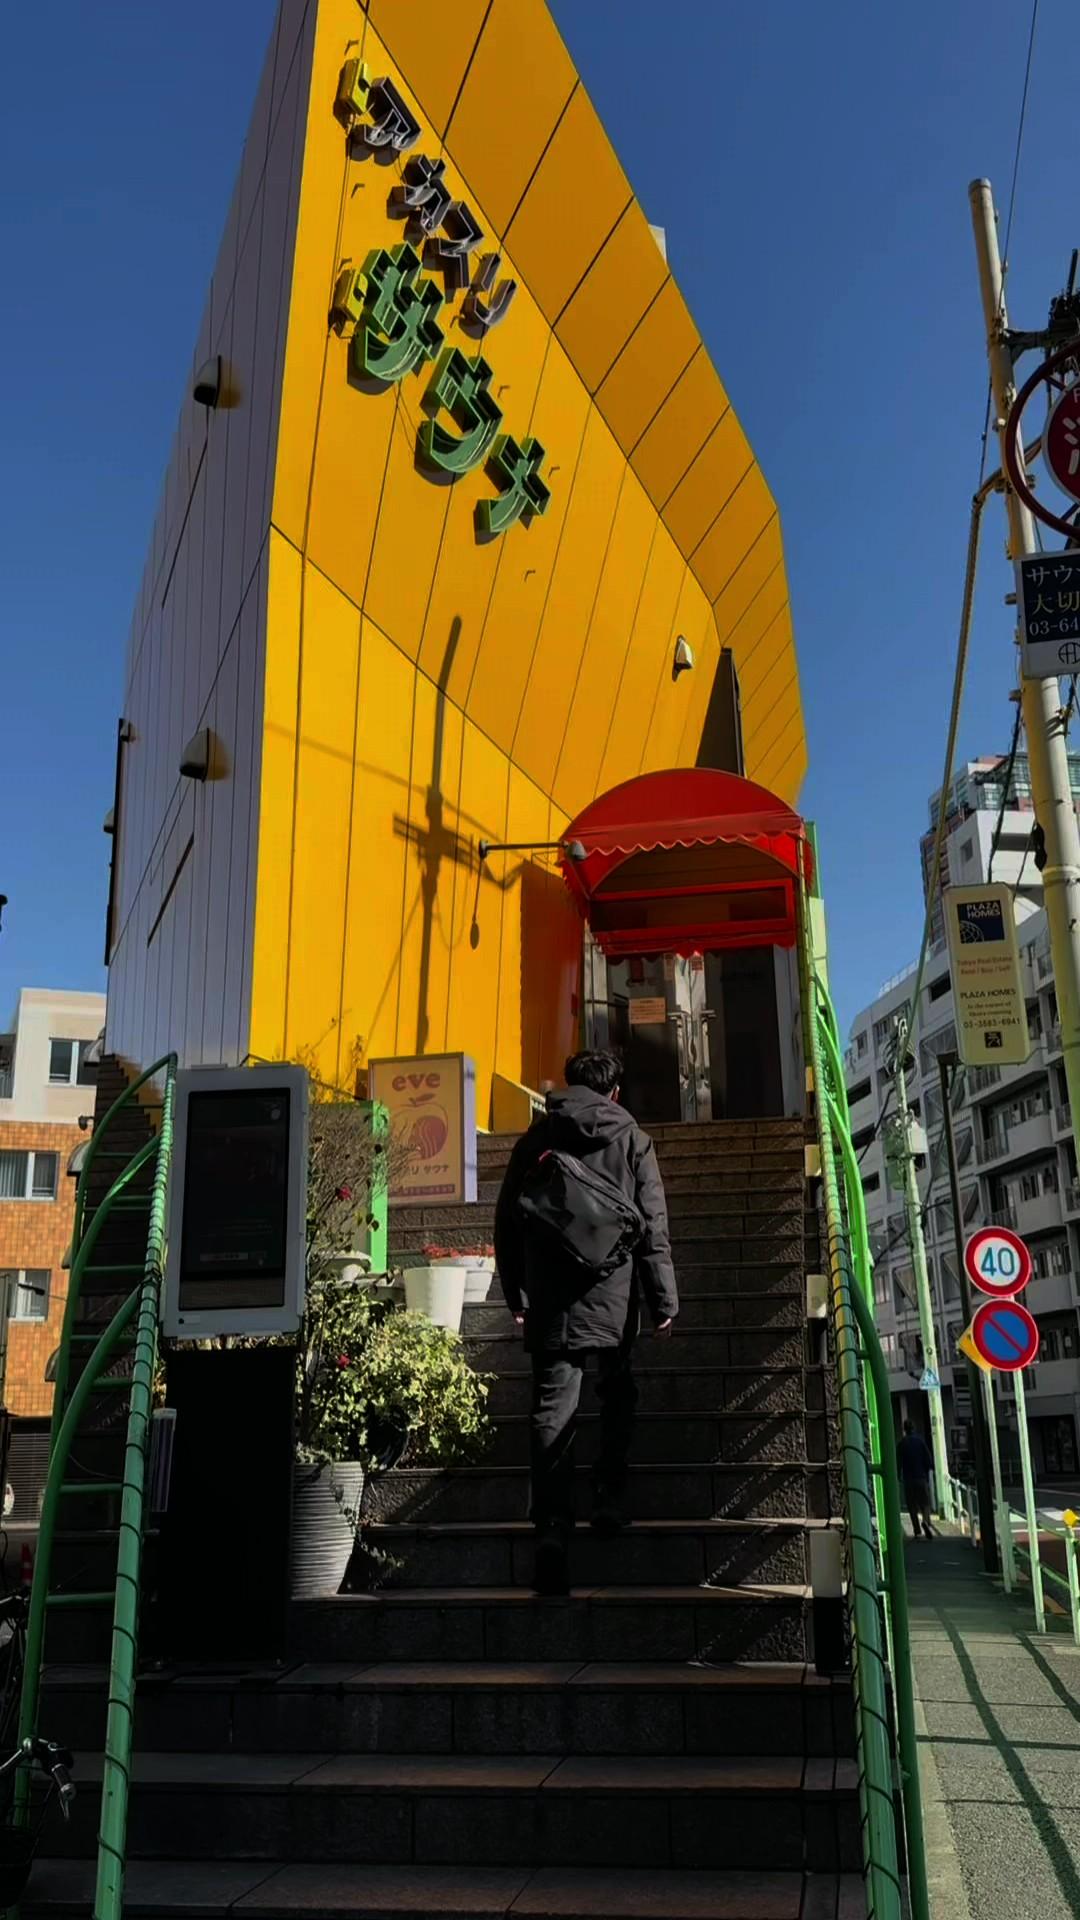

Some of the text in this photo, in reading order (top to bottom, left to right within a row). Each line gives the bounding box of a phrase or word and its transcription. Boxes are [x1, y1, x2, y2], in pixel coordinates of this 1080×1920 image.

[1026, 564, 1080, 587] サウ
[966, 902, 999, 911] PLAZA
[967, 909, 1001, 919] HOMES
[960, 988, 1016, 999] PLAZA HOMES
[392, 1073, 441, 1091] eve
[981, 1247, 1015, 1277] 40
